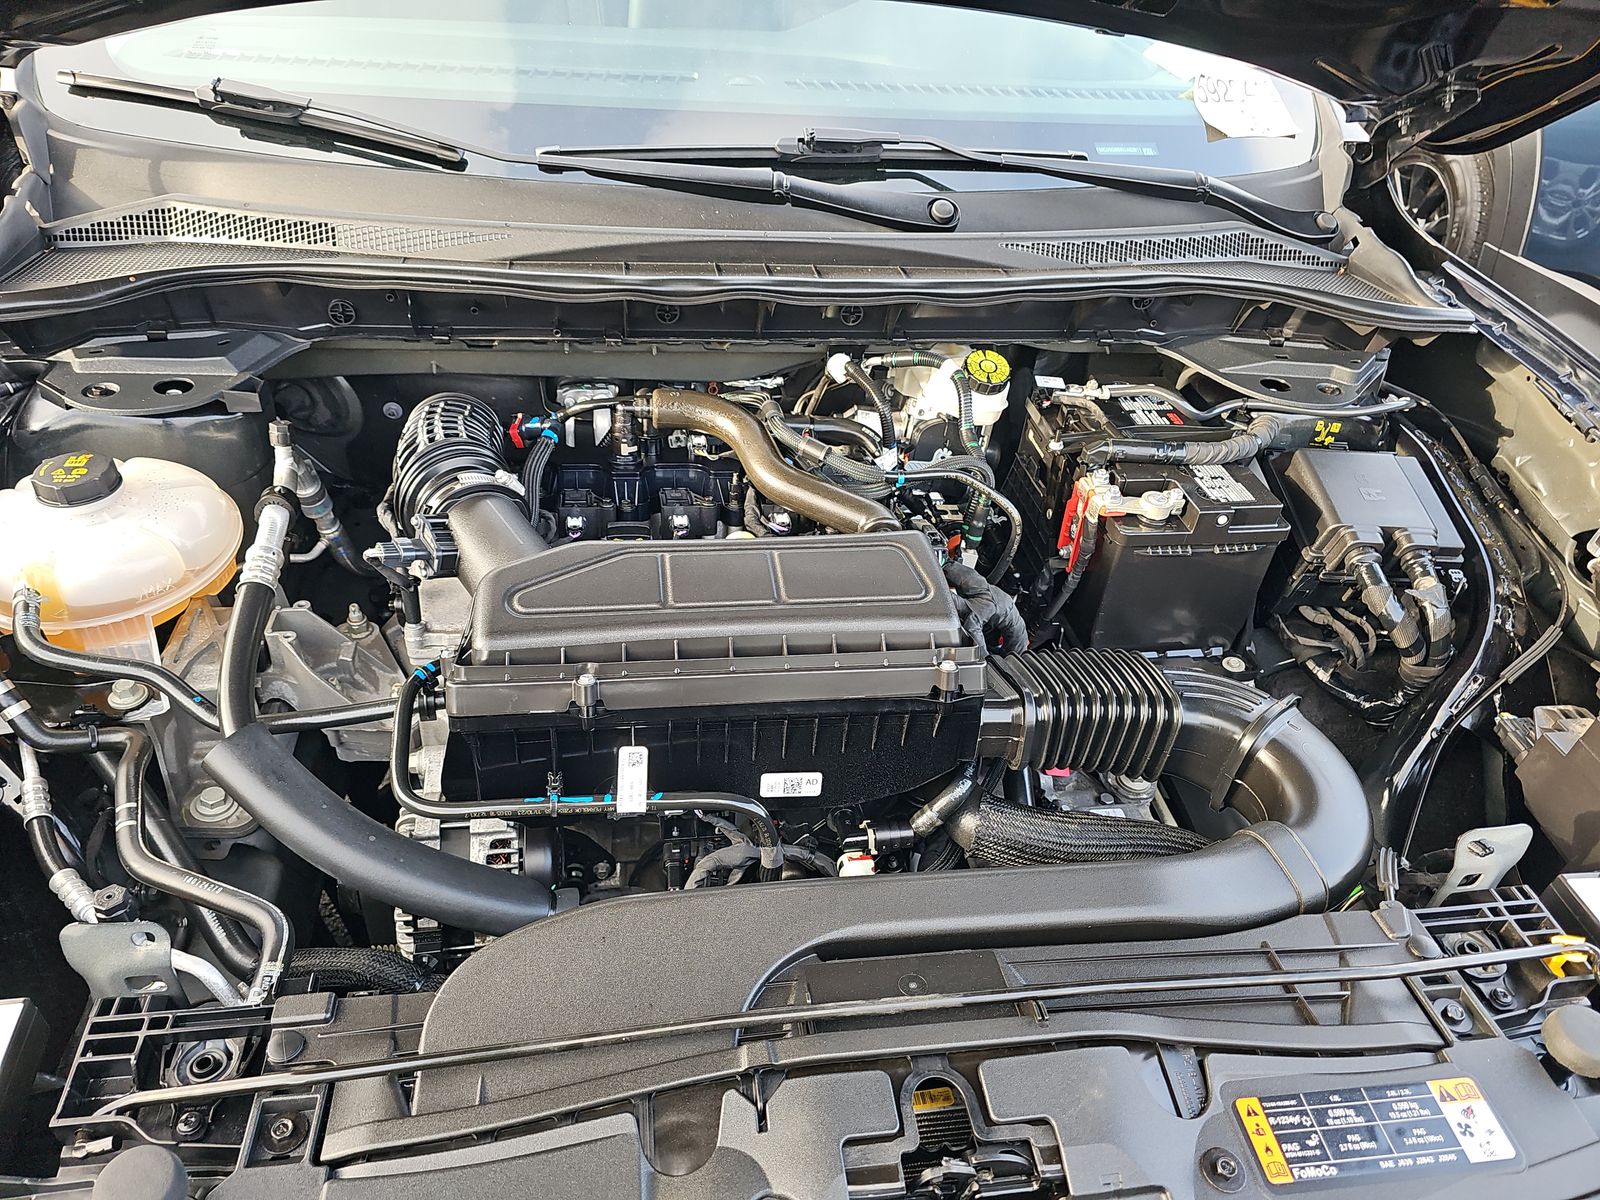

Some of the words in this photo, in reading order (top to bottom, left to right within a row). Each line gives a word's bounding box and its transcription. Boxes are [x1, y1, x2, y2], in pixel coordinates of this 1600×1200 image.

[1412, 1127, 1427, 1137] PAG
[1346, 1133, 1362, 1143] PAG
[1281, 1142, 1301, 1153] PAG
[1292, 1165, 1338, 1179] FoMoCo
